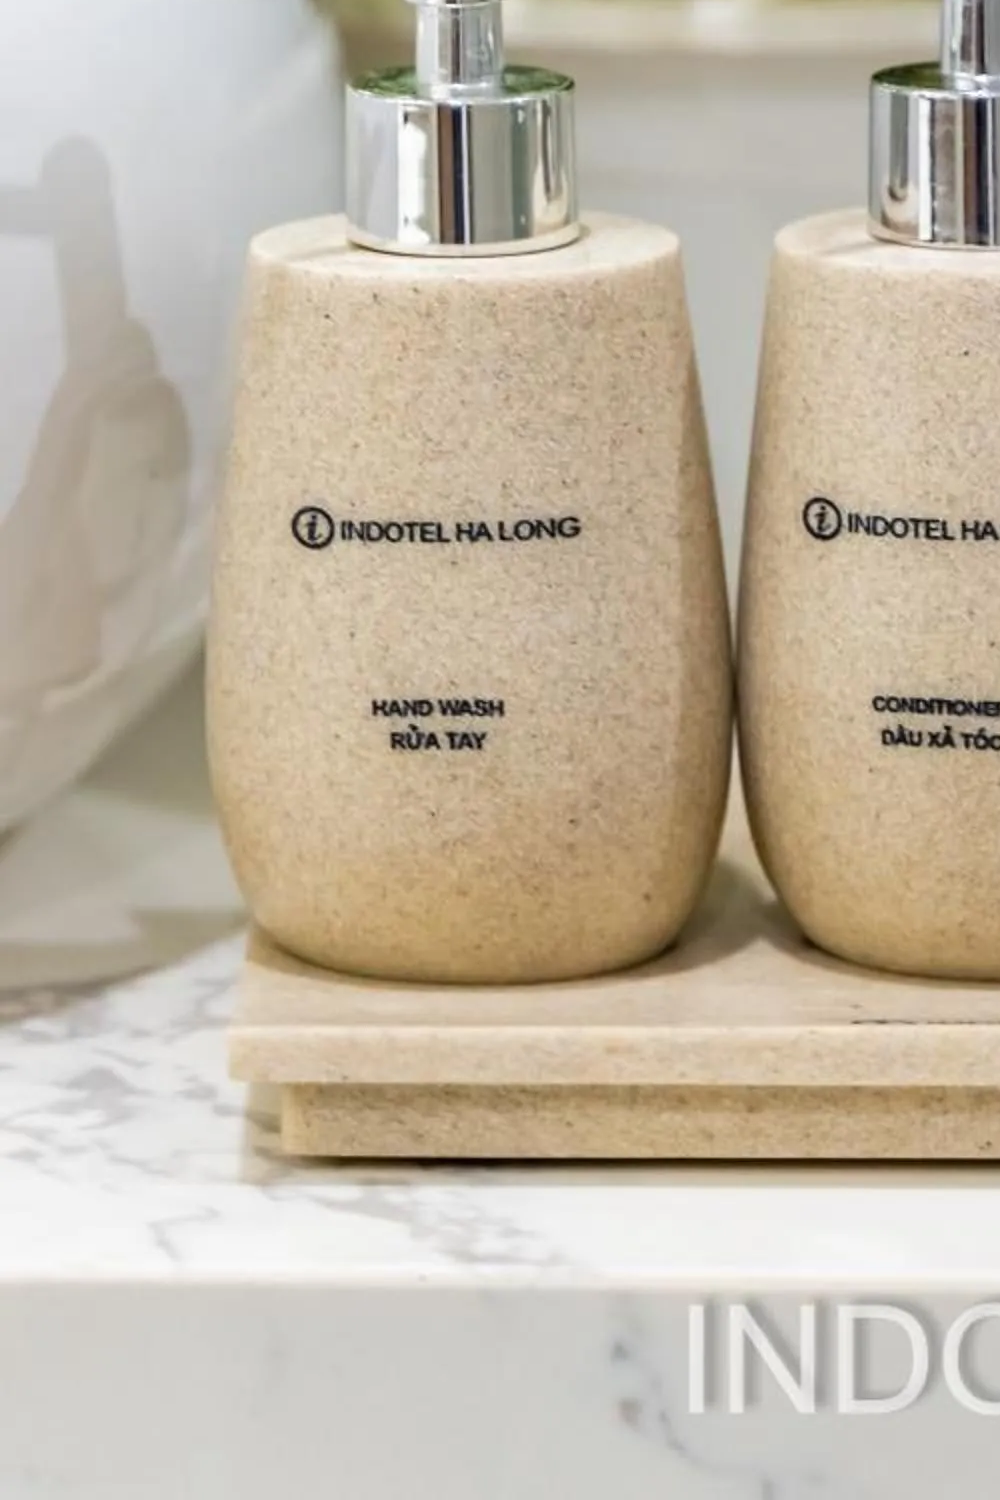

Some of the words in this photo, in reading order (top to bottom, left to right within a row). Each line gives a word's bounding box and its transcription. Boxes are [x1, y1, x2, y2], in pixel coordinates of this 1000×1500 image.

[341, 520, 451, 543] INDOTEL
[498, 516, 582, 541] LONG
[848, 513, 955, 541] INDOTEL
[371, 698, 434, 717] HAND
[437, 698, 505, 717] WASH
[445, 731, 487, 750] TAY
